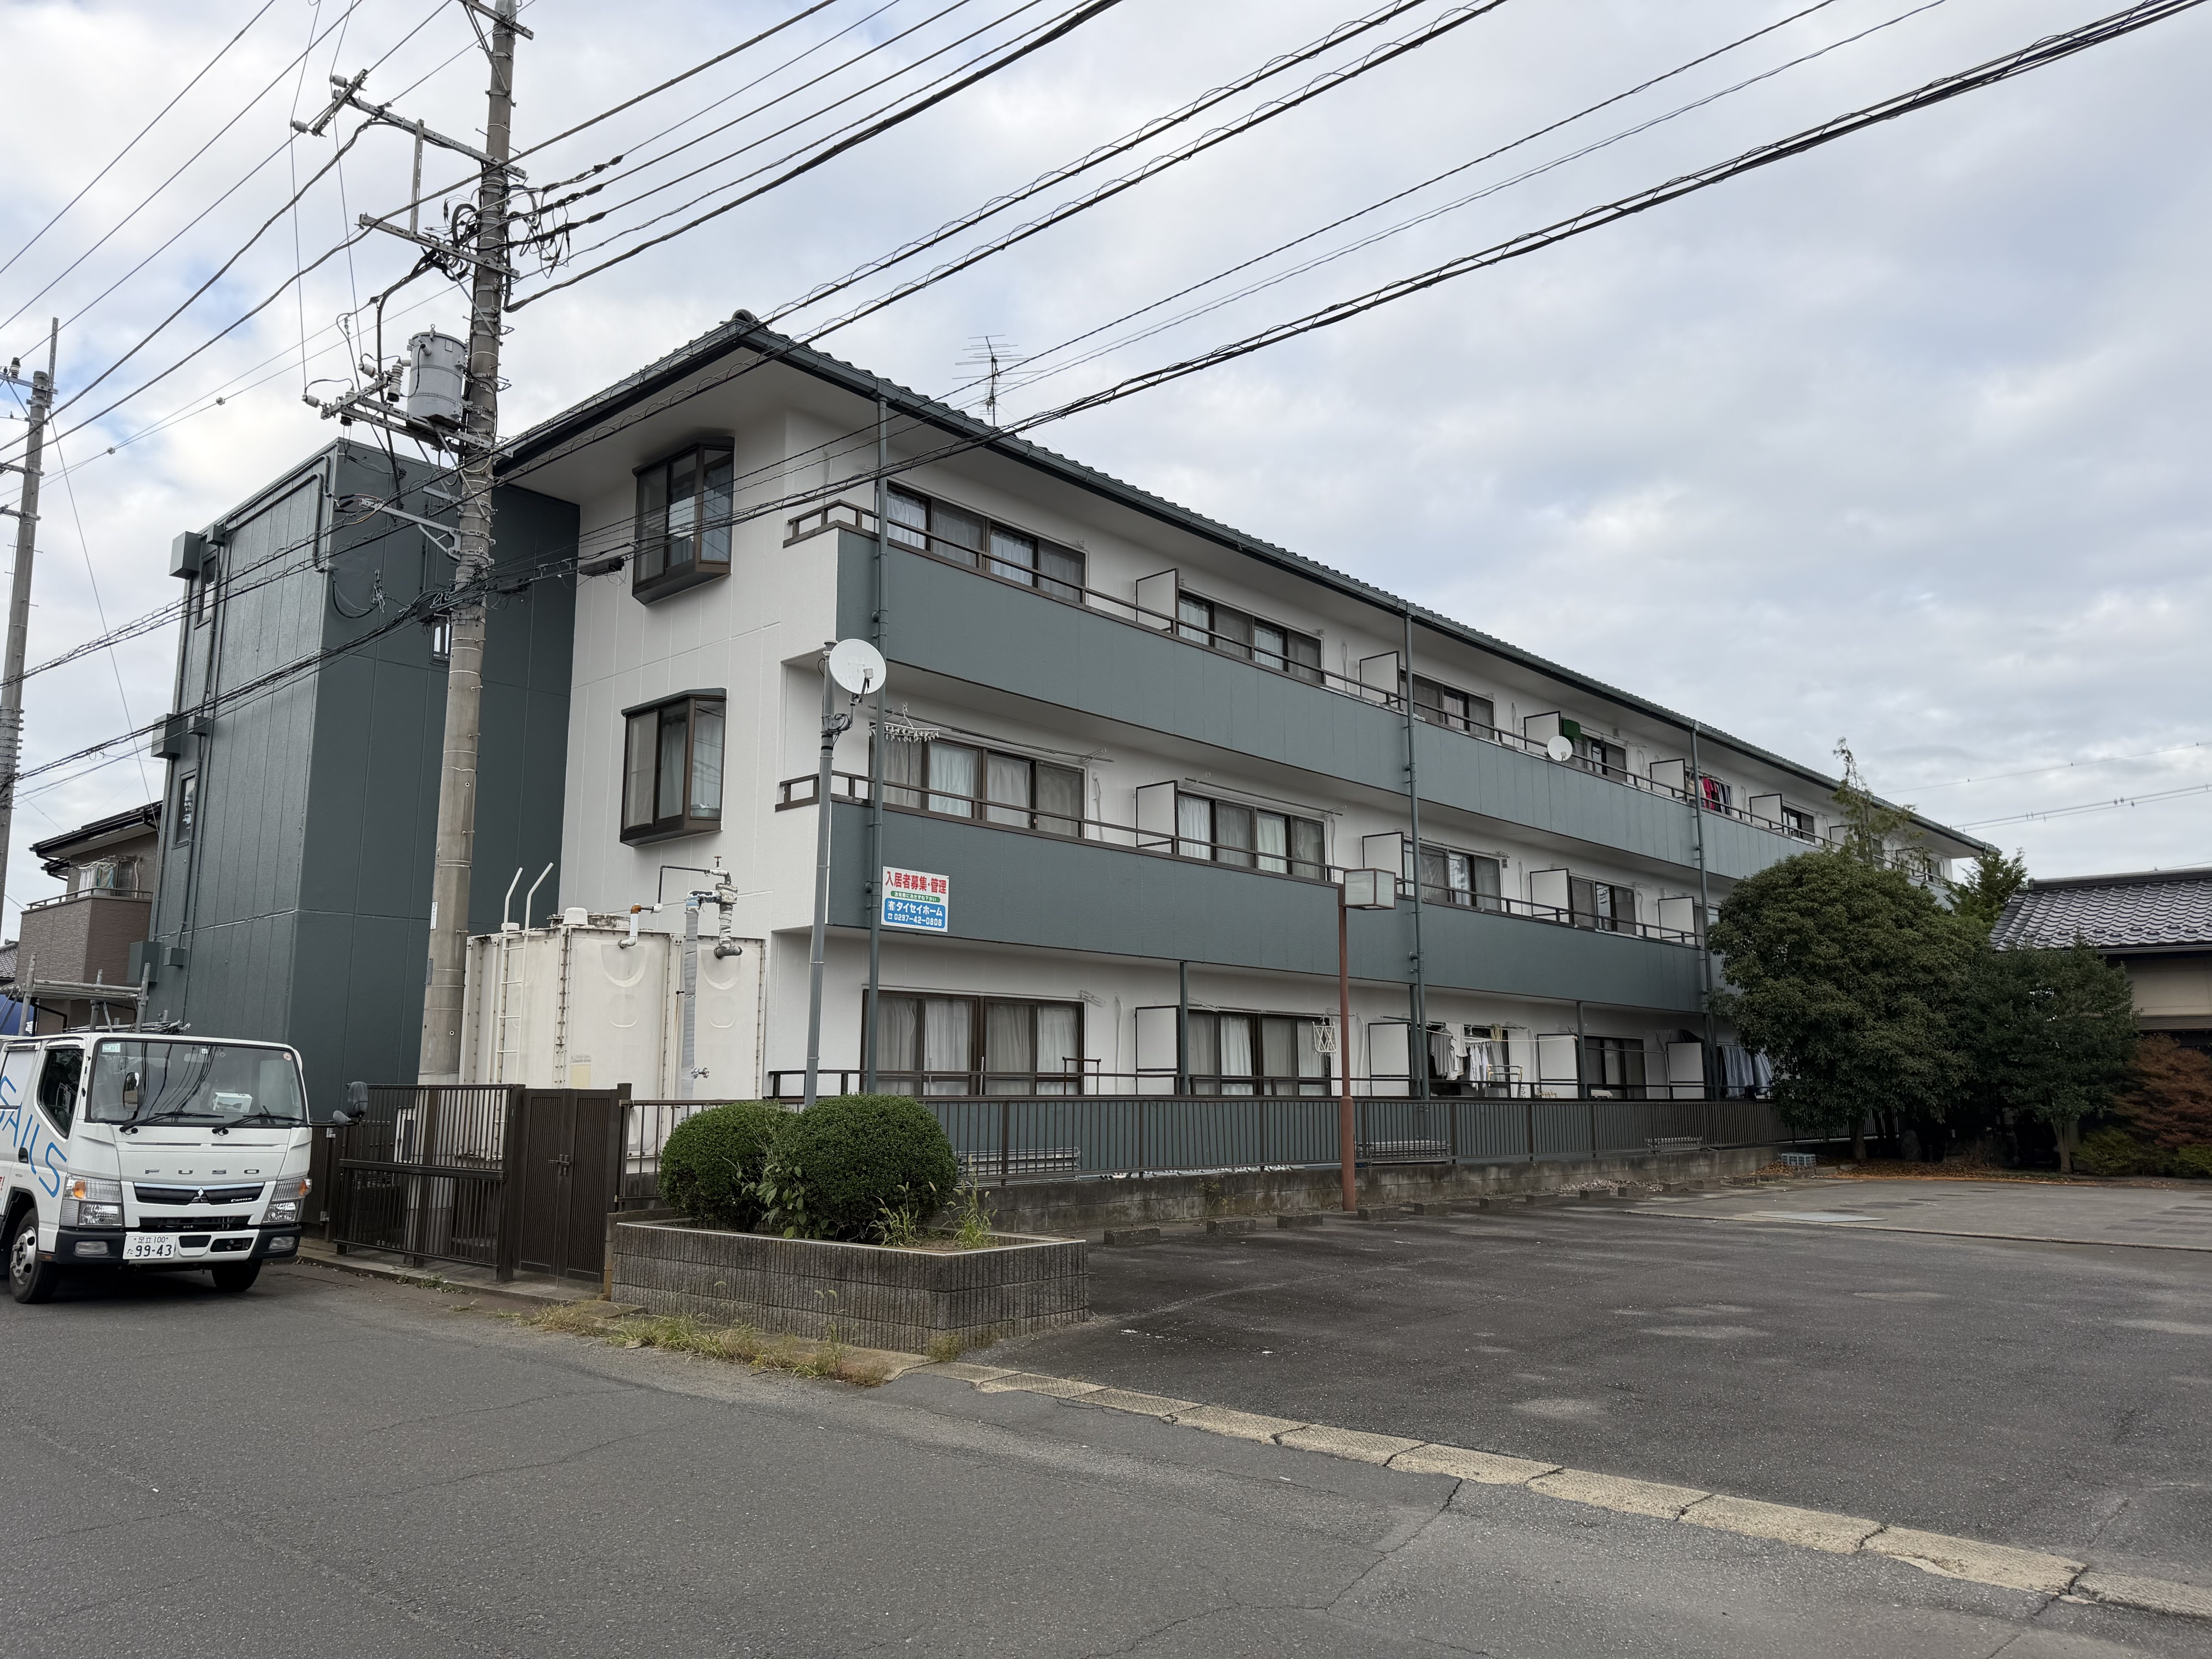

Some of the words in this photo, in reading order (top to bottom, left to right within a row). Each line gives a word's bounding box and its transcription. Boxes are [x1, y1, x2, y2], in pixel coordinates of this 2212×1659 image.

[885, 871, 947, 894] 入居者募集・管理
[894, 913, 942, 926] 0297-42-0808
[135, 1244, 172, 1257] 99-43
